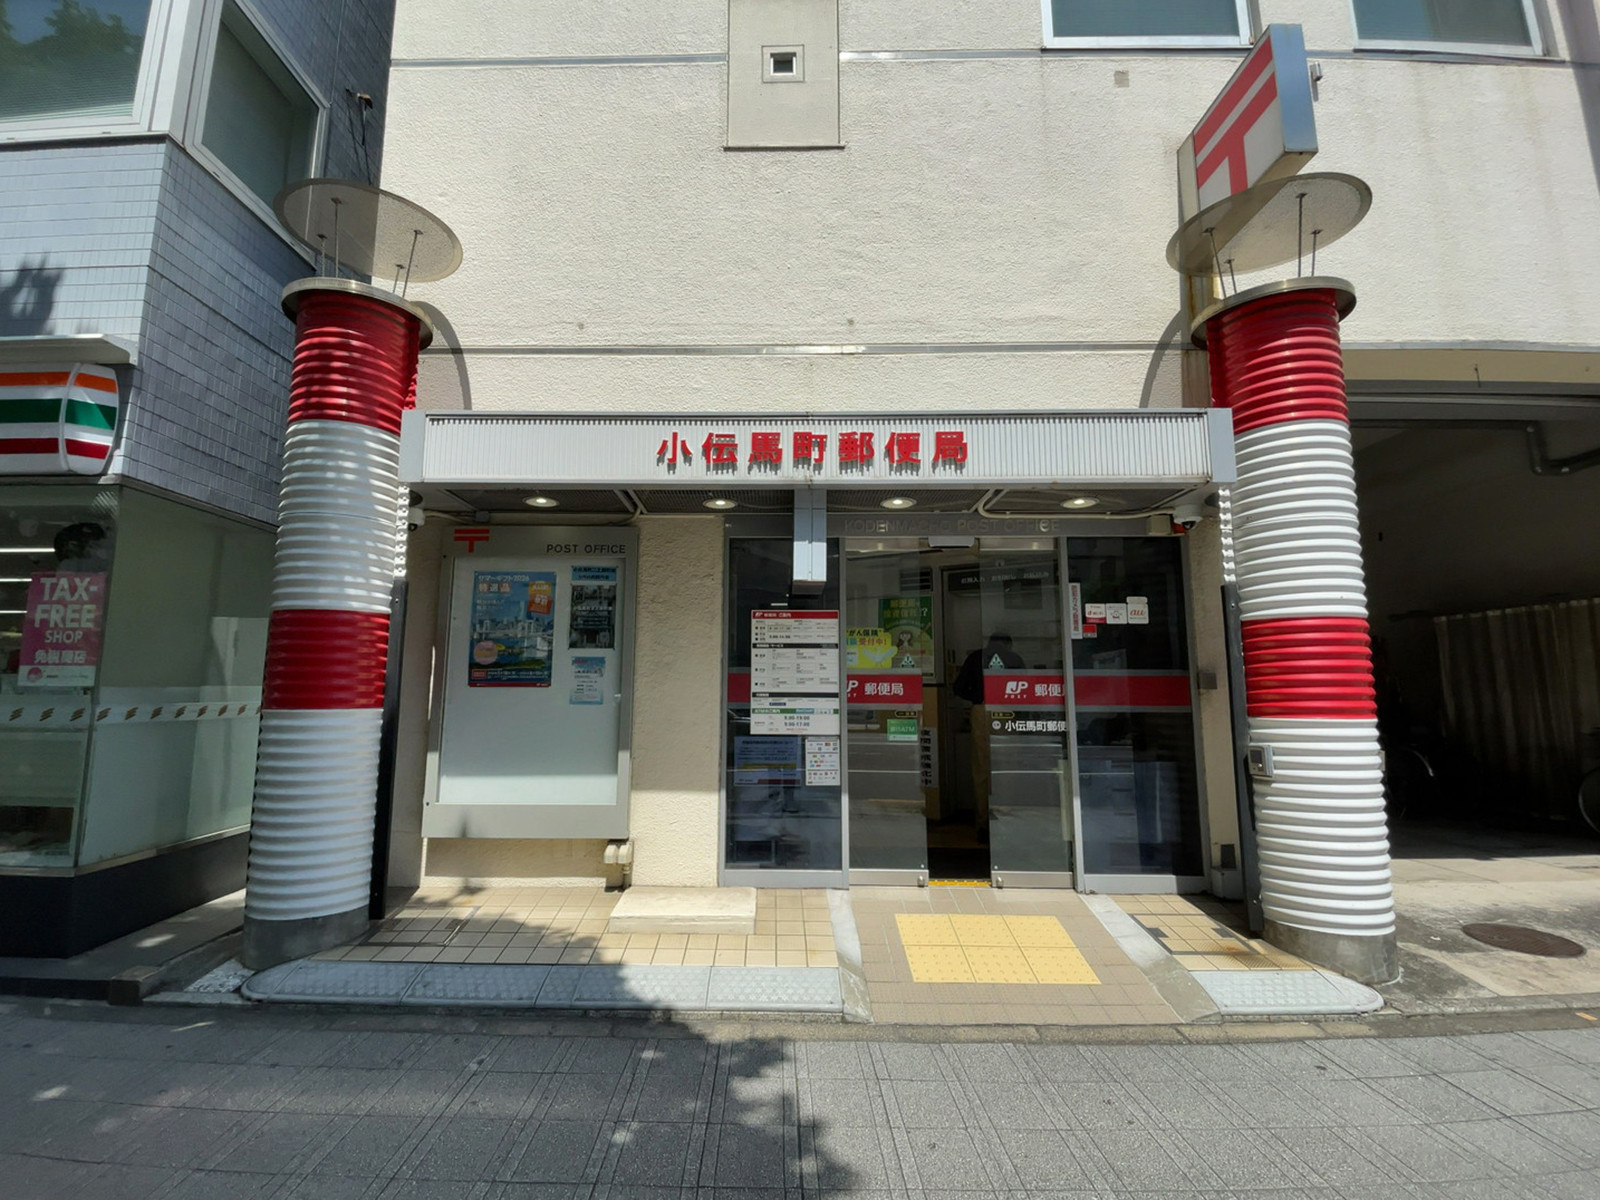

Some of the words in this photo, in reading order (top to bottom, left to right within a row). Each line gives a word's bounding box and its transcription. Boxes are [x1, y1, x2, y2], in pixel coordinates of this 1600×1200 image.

[657, 431, 968, 465] 小伝馬町郵便局
[844, 519, 950, 532] KODENMACHO
[957, 518, 996, 532] POST
[1003, 518, 1060, 532] OFFICE
[546, 544, 578, 553] POST
[584, 544, 626, 554] OFFICE
[40, 577, 98, 601] TAX-
[34, 604, 97, 628] FREE
[44, 630, 83, 643] SHOP
[864, 682, 904, 696] 郵便局
[1034, 683, 1065, 697] 郵便
